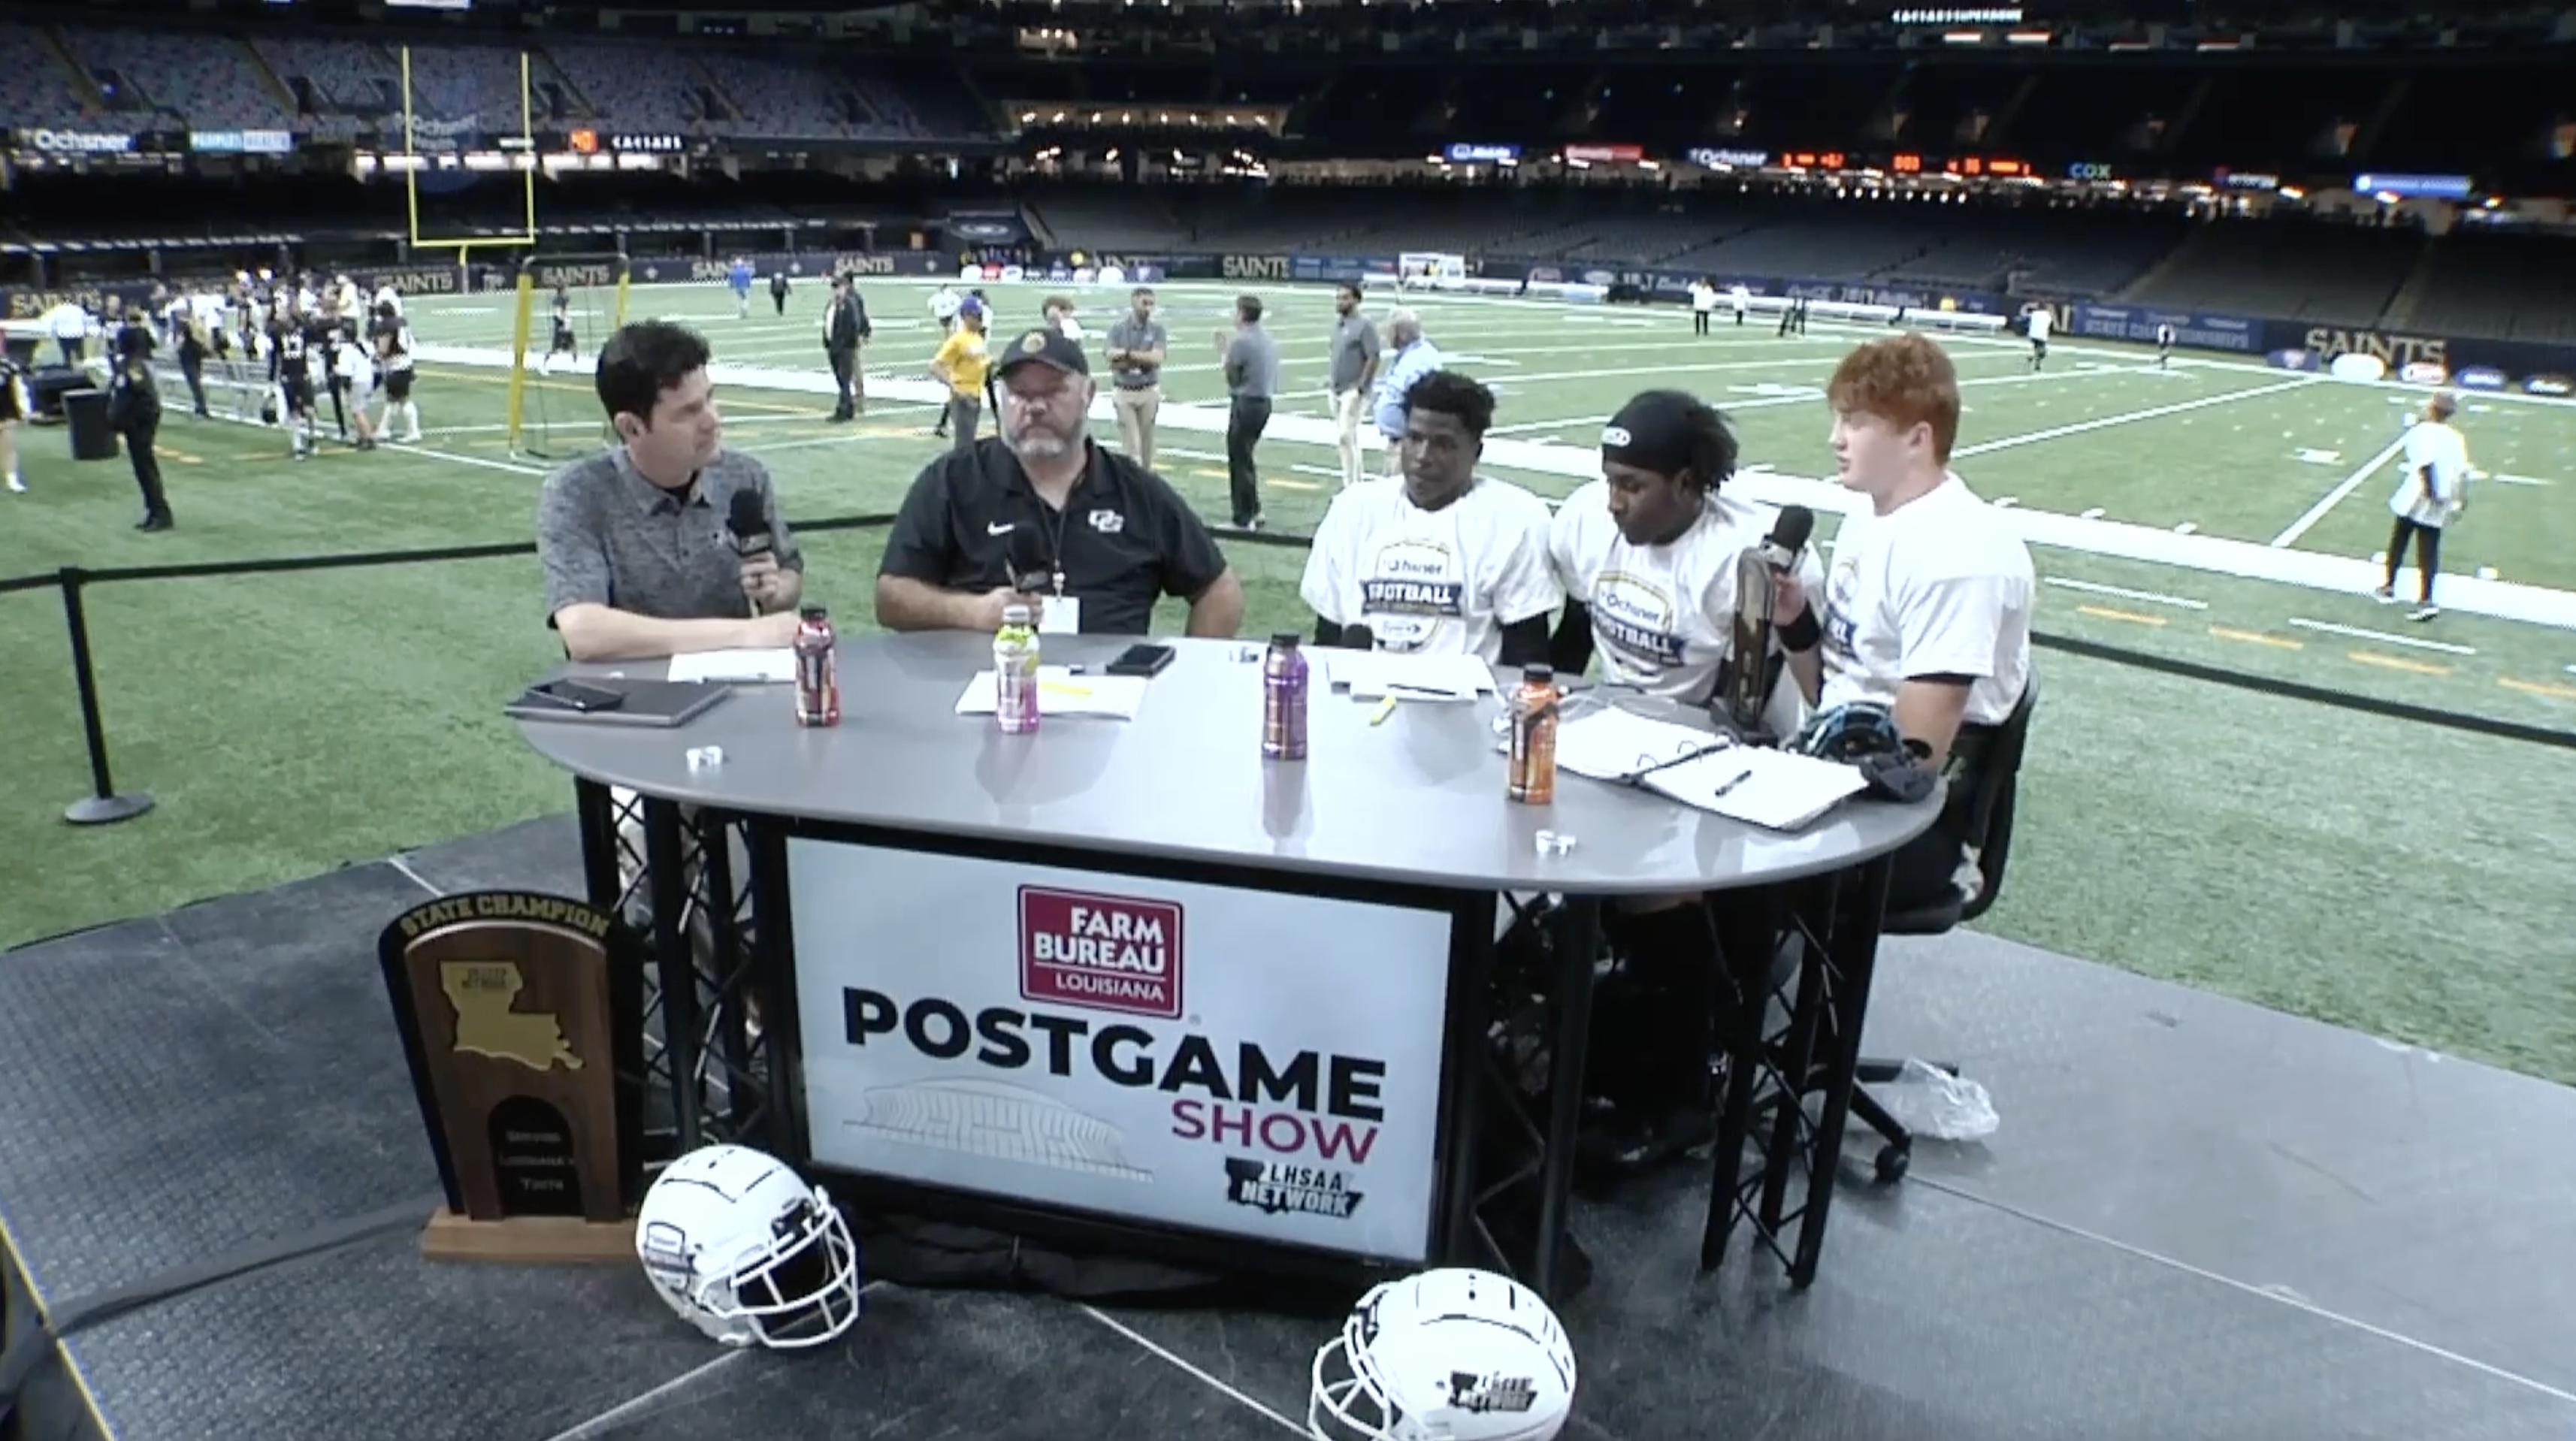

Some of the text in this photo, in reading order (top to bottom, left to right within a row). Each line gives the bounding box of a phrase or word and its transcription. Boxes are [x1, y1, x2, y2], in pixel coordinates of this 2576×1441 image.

[35, 129, 131, 150] Ochsner
[1698, 150, 1767, 167] Ochsner
[2070, 162, 2111, 179] COX
[541, 265, 610, 285] SAINTS
[836, 257, 893, 274] SAINTS
[2306, 328, 2446, 364] SAINTS
[400, 894, 610, 938] STATE CHAMPION
[1071, 906, 1164, 945] FARM
[1033, 932, 1165, 974] BUREAU
[1056, 972, 1165, 1003] LOUISIANA
[843, 986, 1386, 1122] POSTGAME
[1172, 1099, 1378, 1164] SHOW
[1269, 1165, 1343, 1192] LHSAA
[1240, 1180, 1350, 1216] NETWORK
